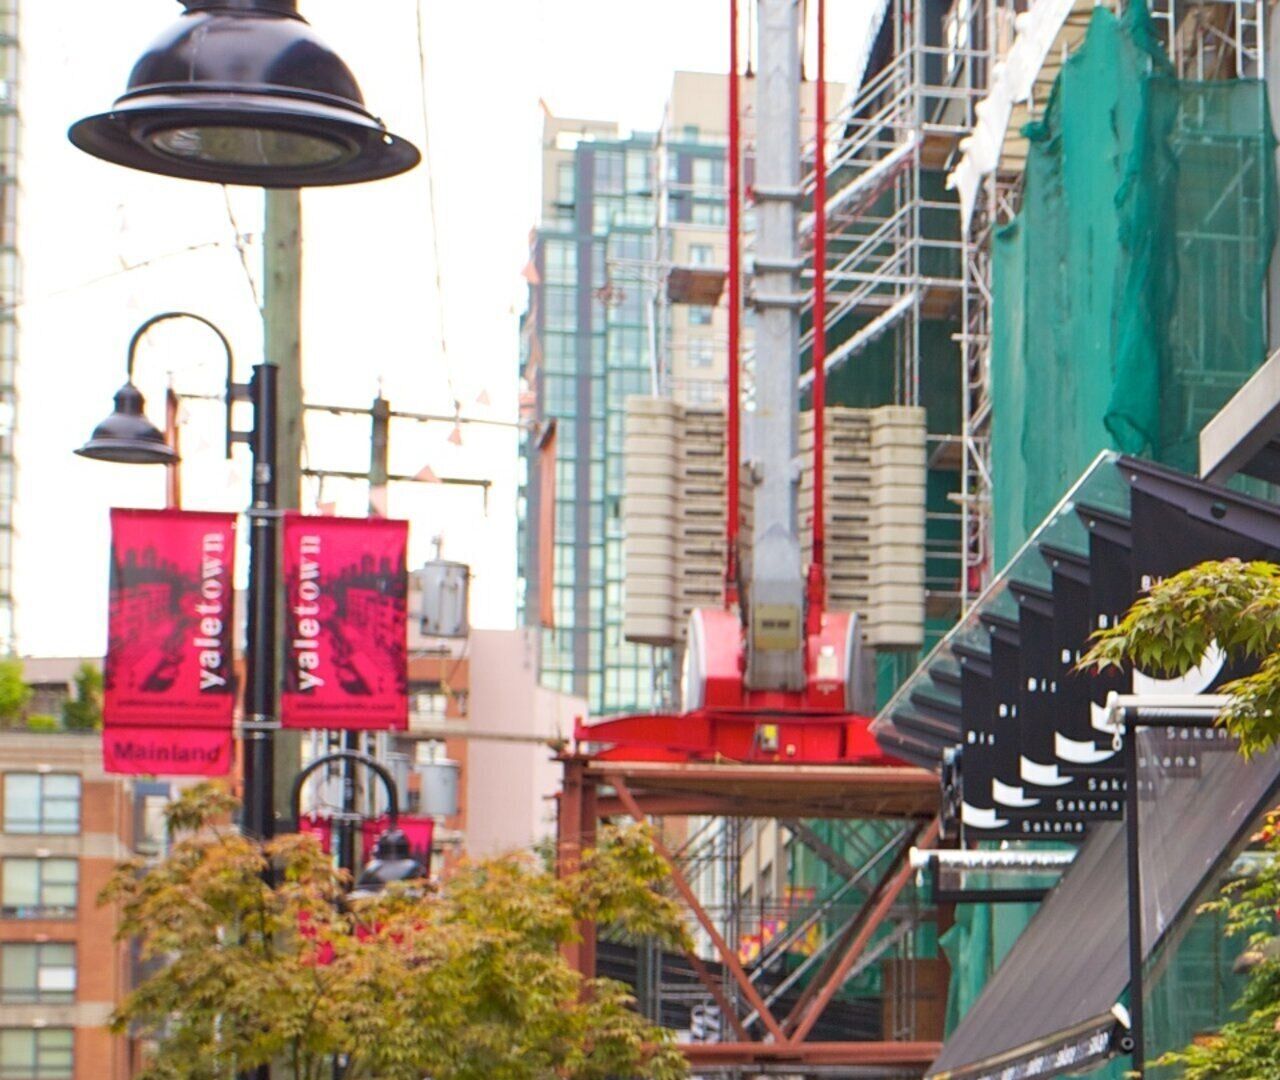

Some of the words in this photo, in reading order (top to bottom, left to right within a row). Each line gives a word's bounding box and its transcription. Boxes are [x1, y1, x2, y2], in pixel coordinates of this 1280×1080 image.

[194, 532, 226, 691] yaletown
[294, 535, 324, 691] yaletown
[113, 742, 222, 764] Mainland
[1139, 755, 1197, 769] akana
